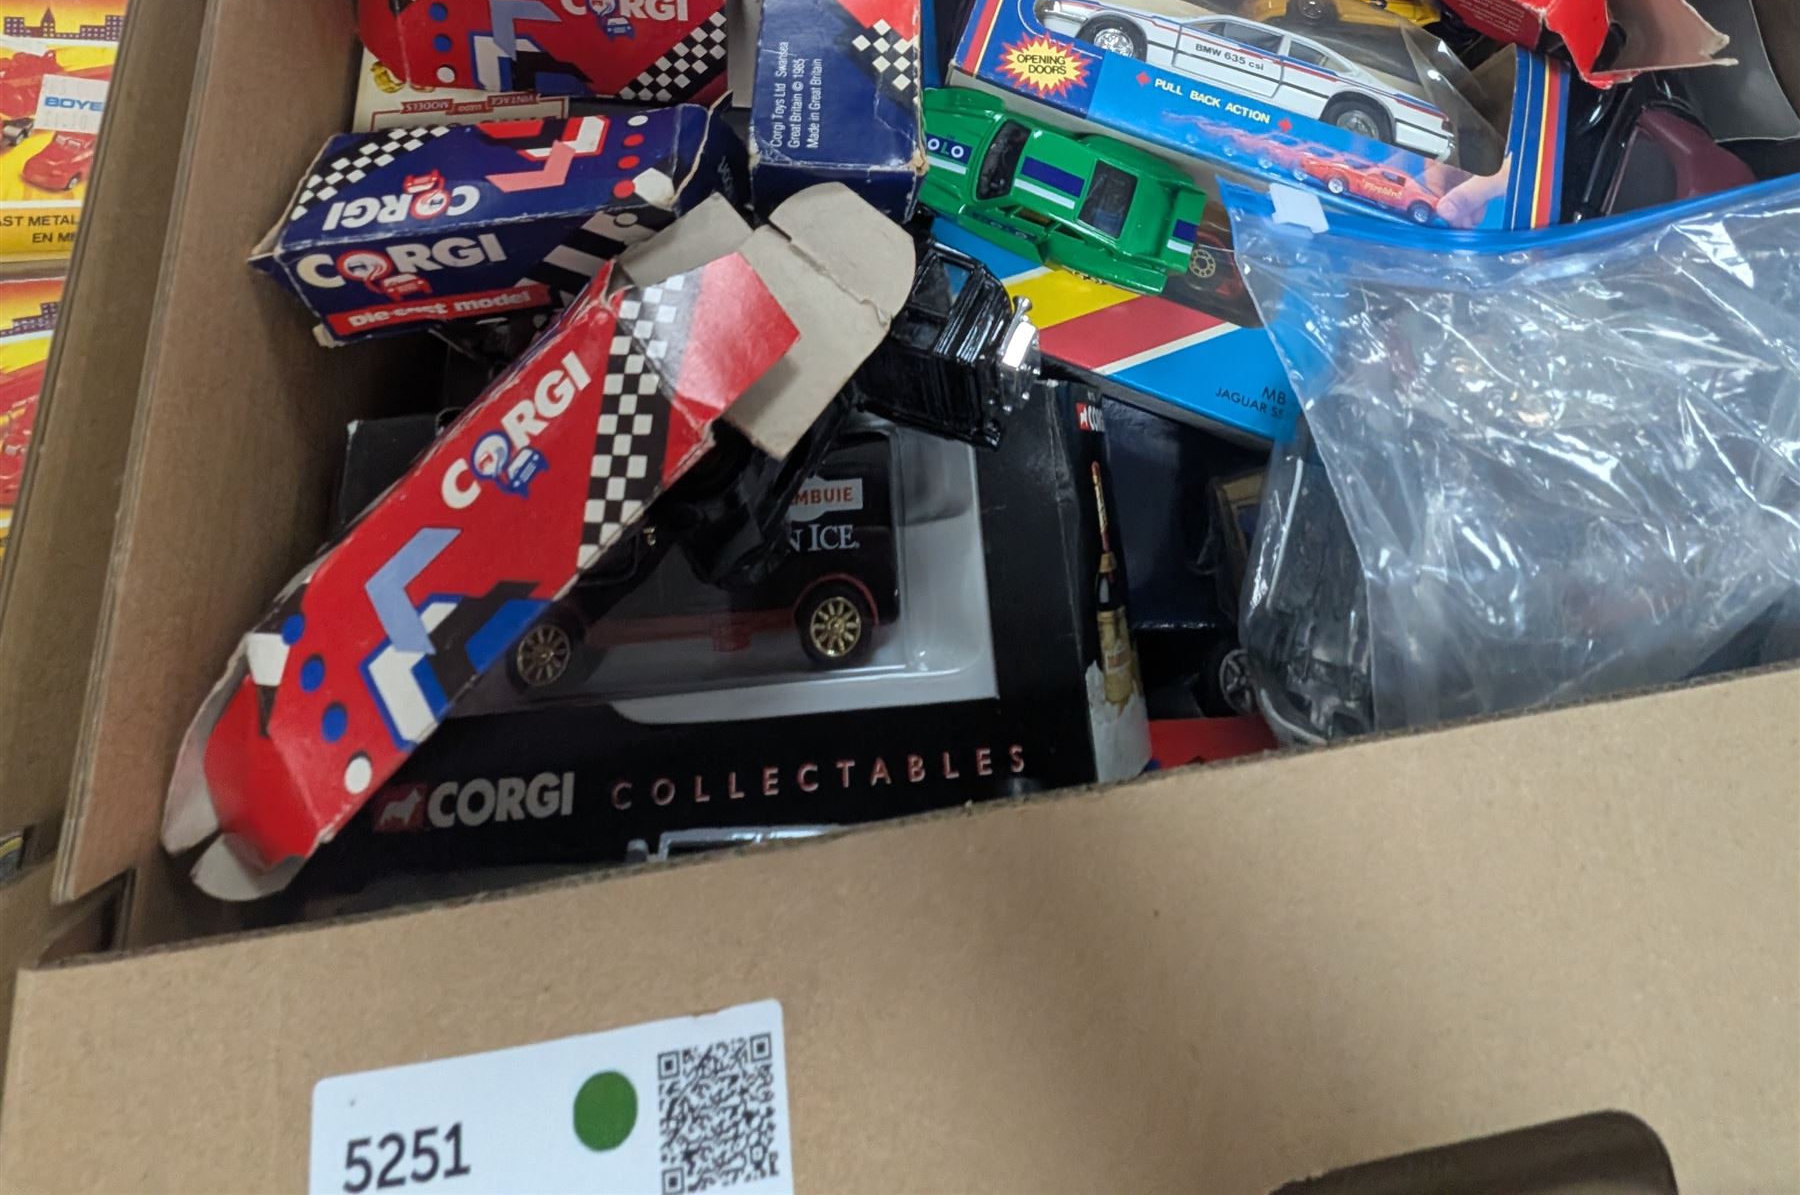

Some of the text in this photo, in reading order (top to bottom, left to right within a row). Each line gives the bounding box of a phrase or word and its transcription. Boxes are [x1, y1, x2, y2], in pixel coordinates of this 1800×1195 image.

[1017, 53, 1066, 65] OPENING
[1195, 43, 1222, 57] BMW
[1224, 52, 1246, 66] 635
[1028, 63, 1067, 75] DOORS
[406, 101, 449, 111] MODELS
[770, 41, 789, 148] Corgi Toys Ltd Swansea
[789, 93, 803, 122] Britain
[806, 58, 823, 149] Made in Great Britain
[1155, 77, 1271, 124] PULL BACK ACTION
[787, 123, 802, 149] Great
[0, 215, 24, 227] ST
[322, 185, 481, 231] CORGI
[32, 232, 53, 243] EN
[296, 233, 507, 289] CORGI
[453, 291, 531, 313] model
[1215, 387, 1268, 414] JAGUAR
[441, 350, 592, 510] CORGI
[791, 486, 854, 505] MBUIE
[611, 745, 1025, 810] COLLECTABLES
[427, 771, 575, 828] CORGI
[342, 1121, 471, 1195] 5251
